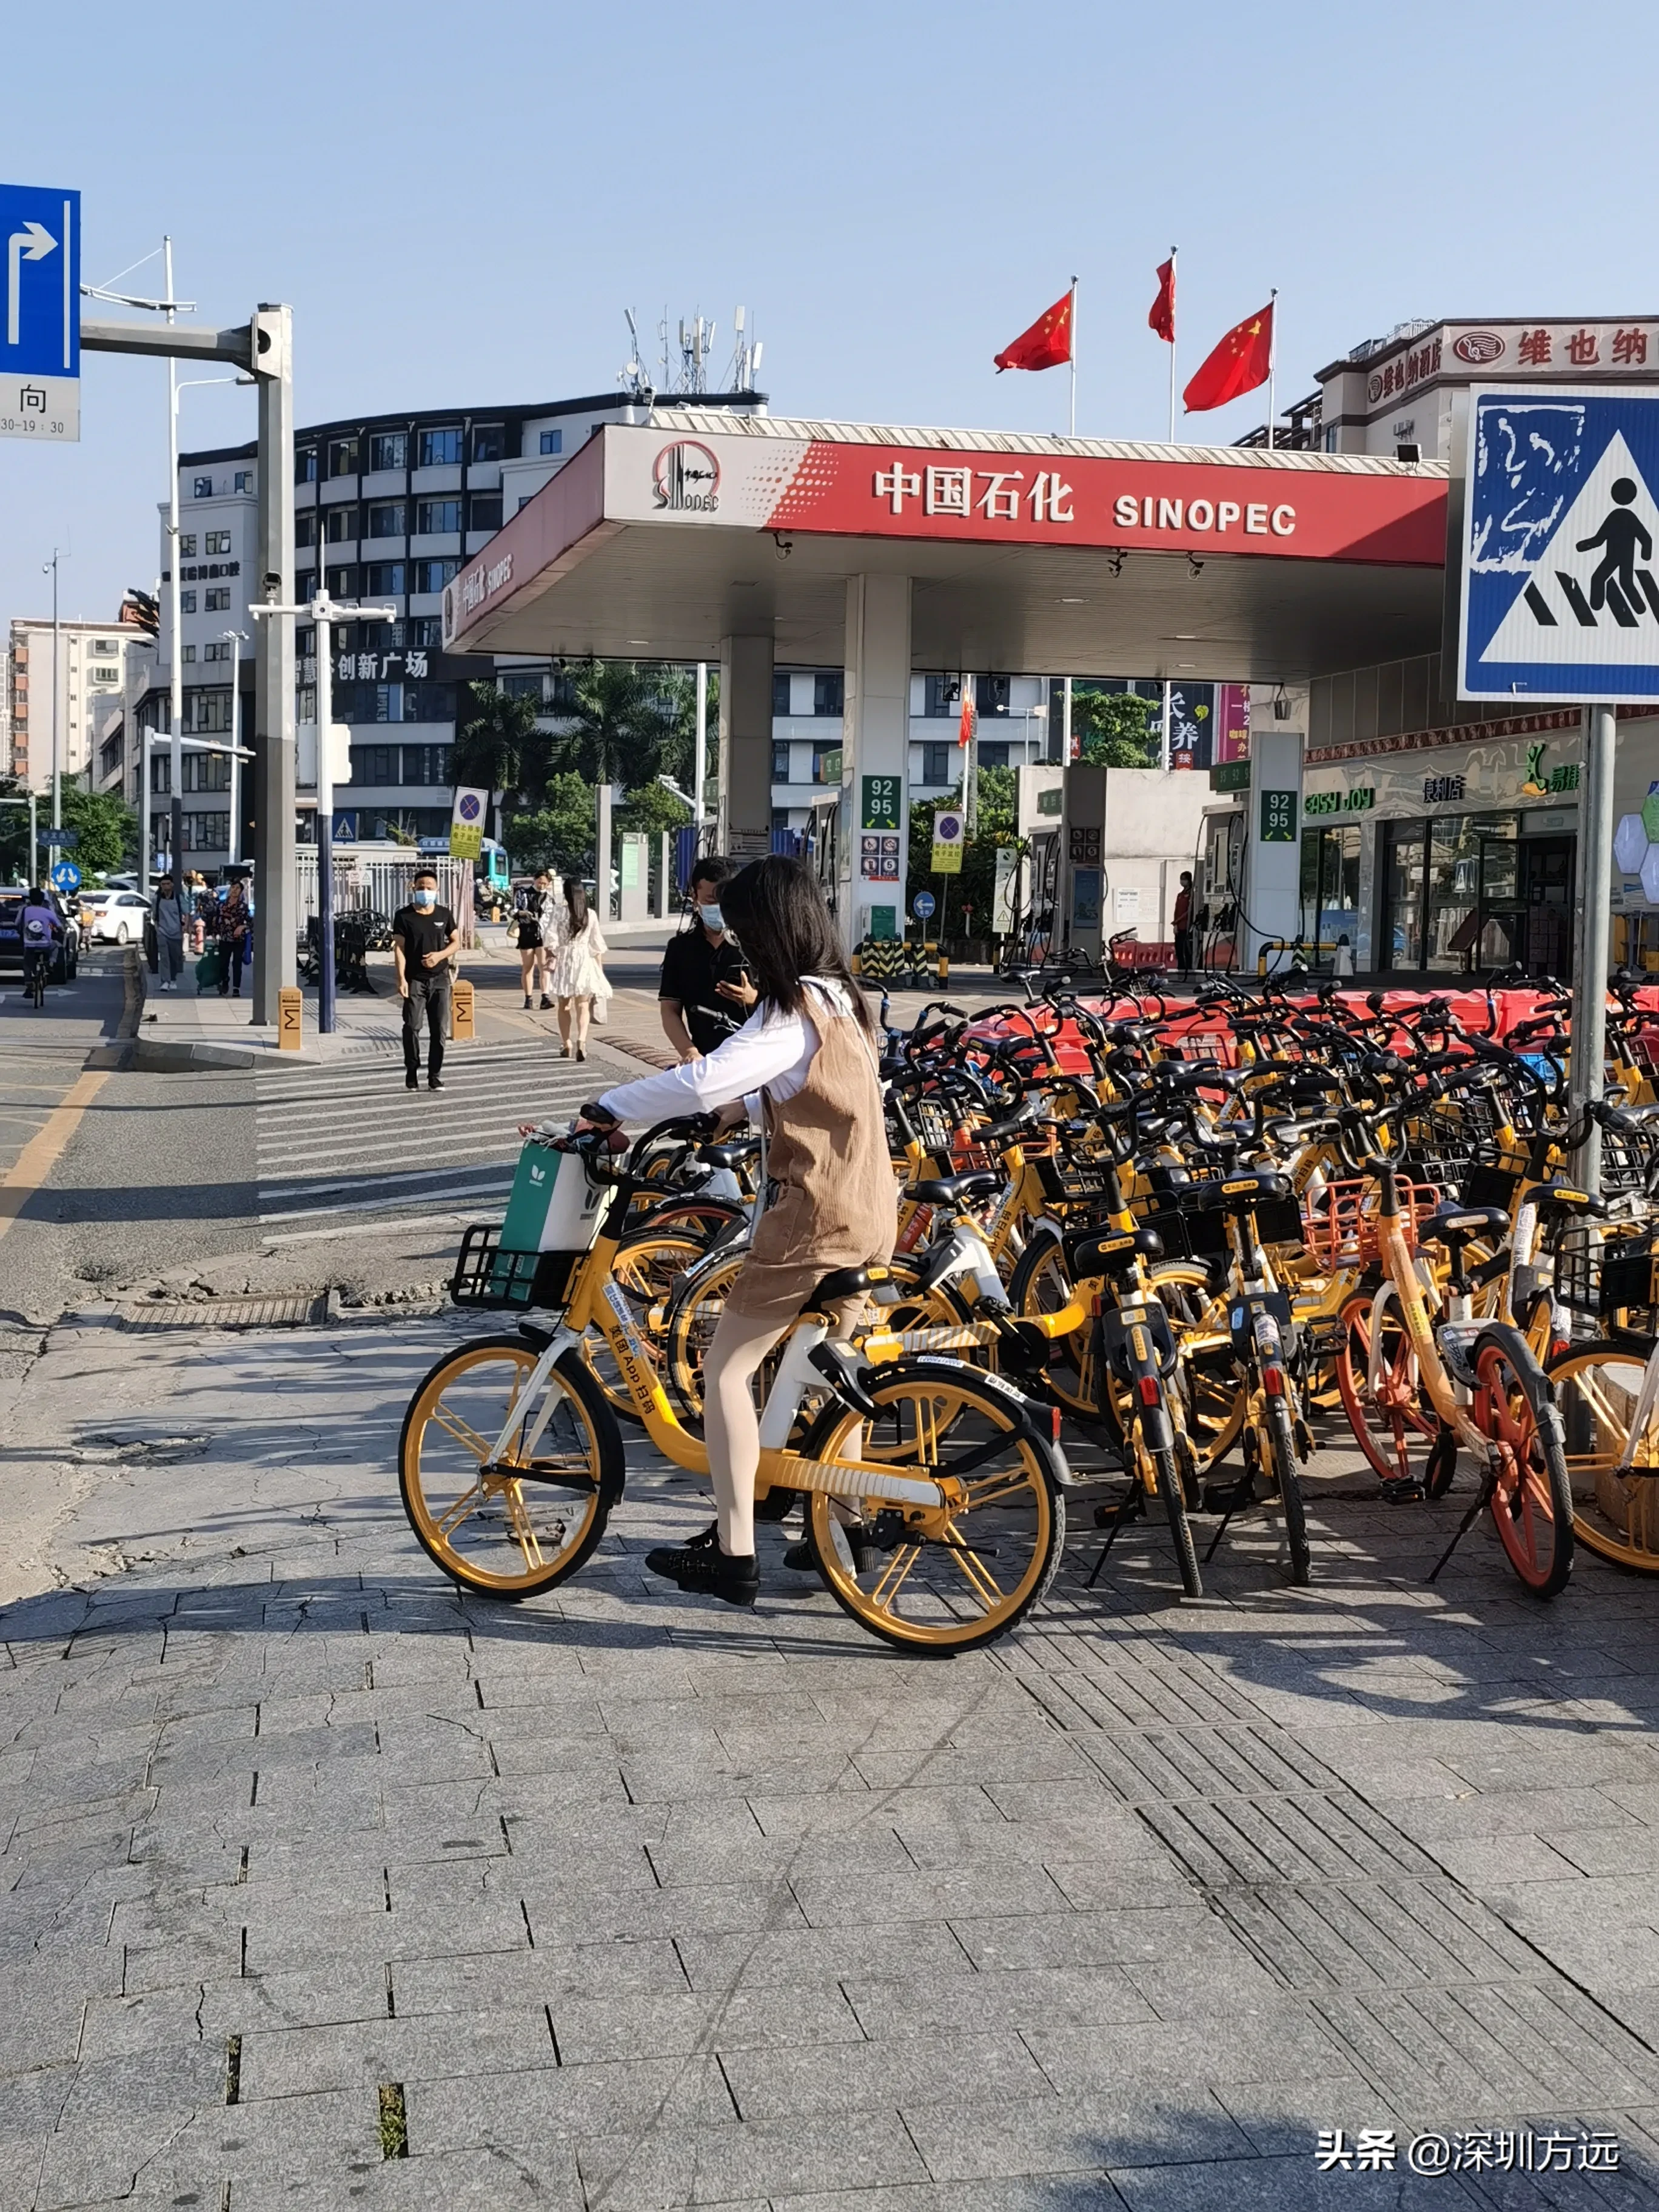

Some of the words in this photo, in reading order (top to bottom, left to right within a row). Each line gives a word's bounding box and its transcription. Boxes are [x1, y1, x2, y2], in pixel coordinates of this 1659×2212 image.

[1518, 327, 1648, 365] 维也纳
[1383, 337, 1443, 399] 维也纳酒店
[20, 384, 46, 414] 向
[874, 462, 1074, 521] 中国石化
[1114, 495, 1296, 537] SINOPEC
[871, 780, 893, 796] 92
[1270, 794, 1289, 809] 92
[1424, 775, 1464, 803] 便利店
[871, 799, 893, 815] 95
[1305, 792, 1338, 814] EASY
[1269, 813, 1289, 828] 95
[609, 1324, 629, 1353] 美团
[623, 1356, 640, 1384] App
[635, 1384, 655, 1414] 扫码
